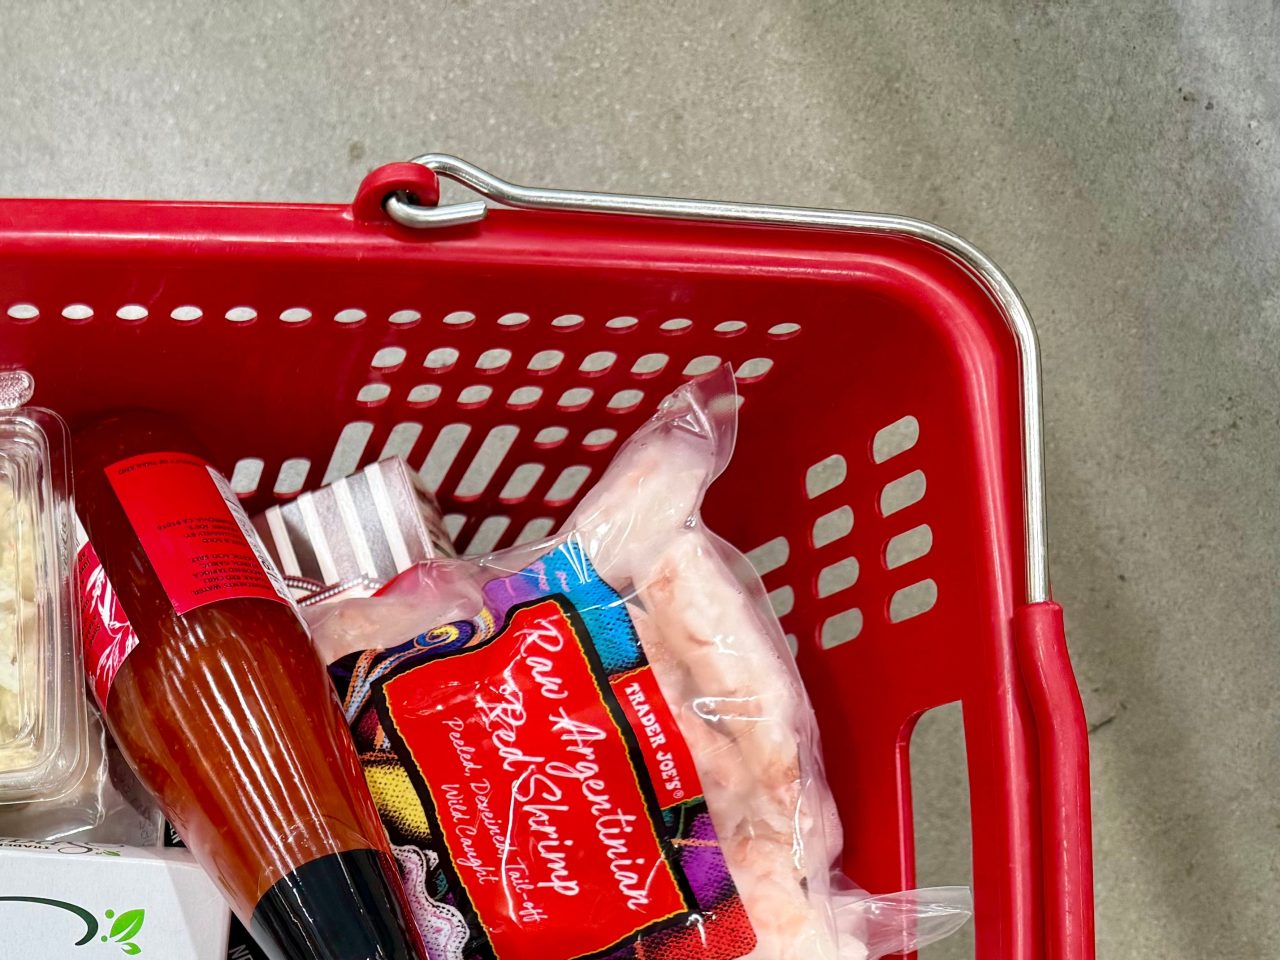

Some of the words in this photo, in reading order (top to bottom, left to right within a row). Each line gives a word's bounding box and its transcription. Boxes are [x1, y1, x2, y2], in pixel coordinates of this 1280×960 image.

[441, 717, 483, 777] Peeled,
[470, 778, 512, 858] Deveined,
[505, 856, 549, 923] Tail-off
[441, 784, 470, 823] Wild
[456, 825, 499, 885] Caught
[475, 691, 545, 772] Red
[512, 774, 580, 897] Shrimp
[513, 616, 569, 699] Raw
[544, 706, 650, 910] Argentinian
[624, 682, 667, 749] TRADER
[655, 750, 683, 791] JOE'S
